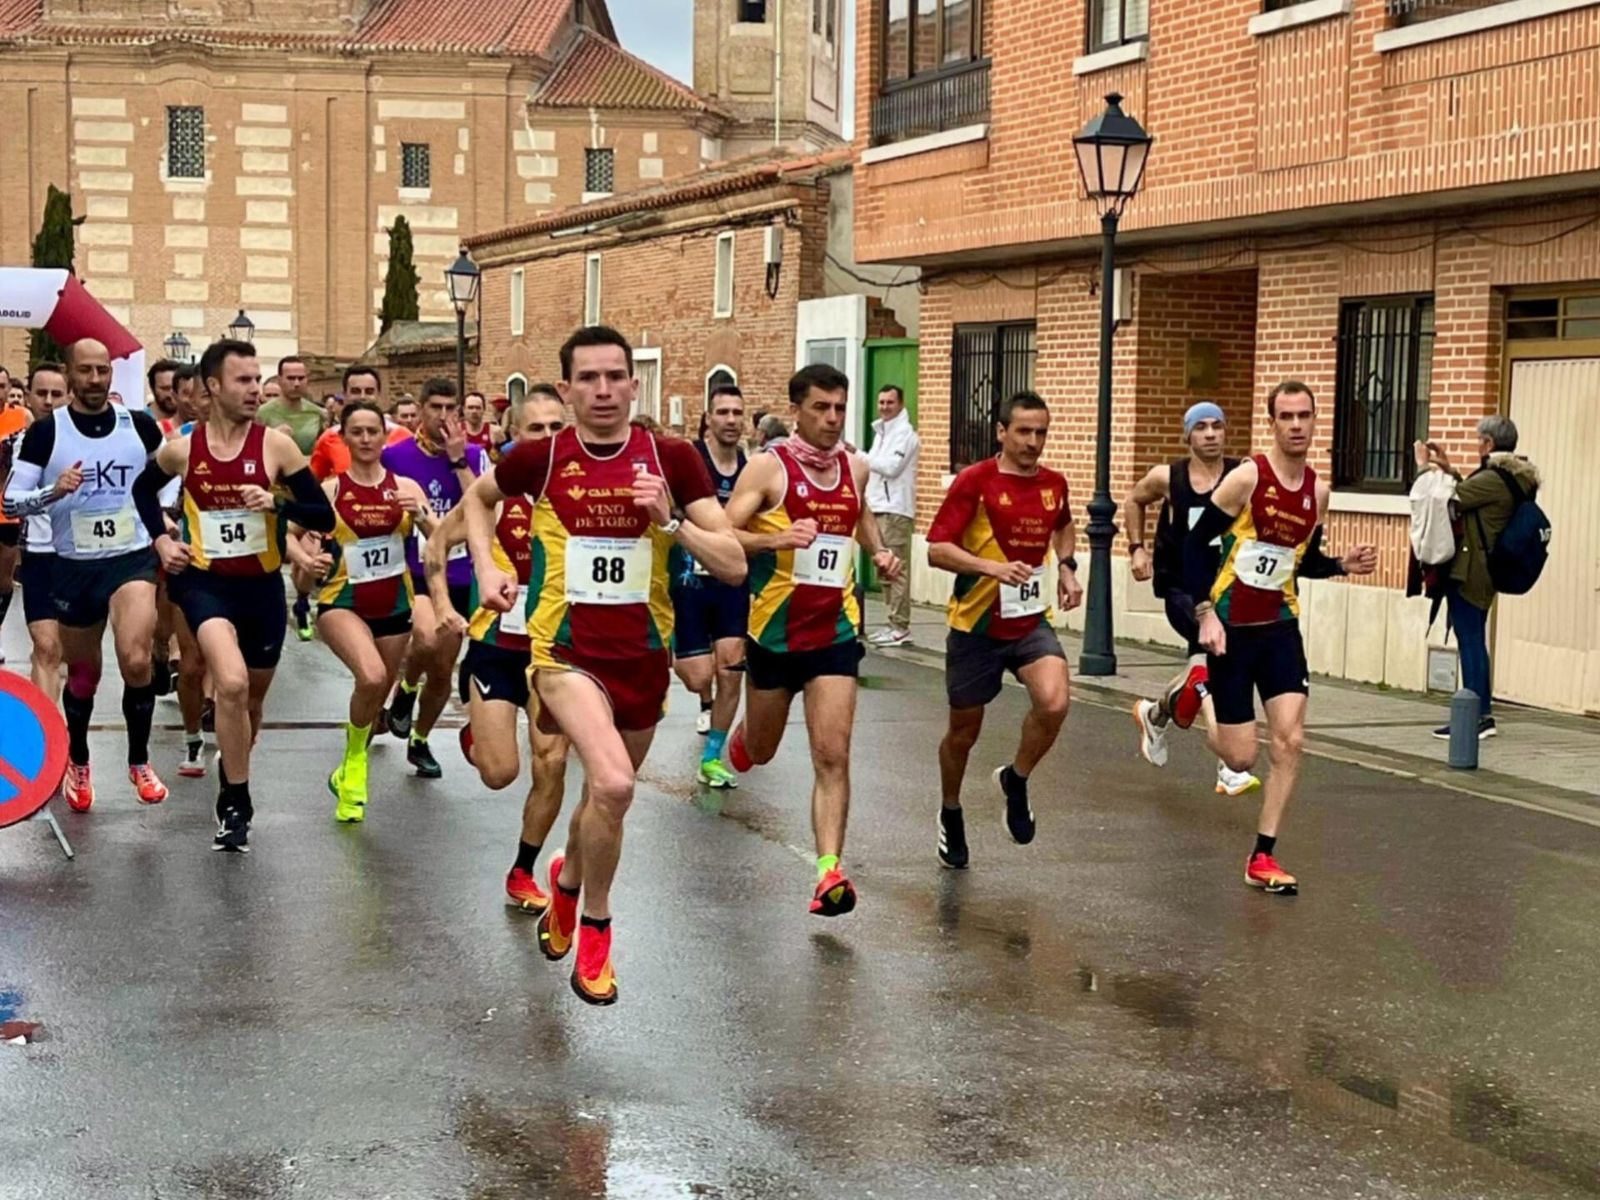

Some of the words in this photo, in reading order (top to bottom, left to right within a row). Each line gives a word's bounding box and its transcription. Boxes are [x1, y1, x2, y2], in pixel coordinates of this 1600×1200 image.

[587, 504, 625, 515] VINO
[93, 519, 116, 538] 43
[220, 523, 246, 543] 54
[575, 517, 594, 528] DE
[596, 517, 638, 528] TORO
[362, 547, 389, 569] 127
[817, 549, 838, 570] 67
[1255, 555, 1278, 577] 37
[592, 556, 626, 584] 88
[1020, 581, 1040, 602] 64
